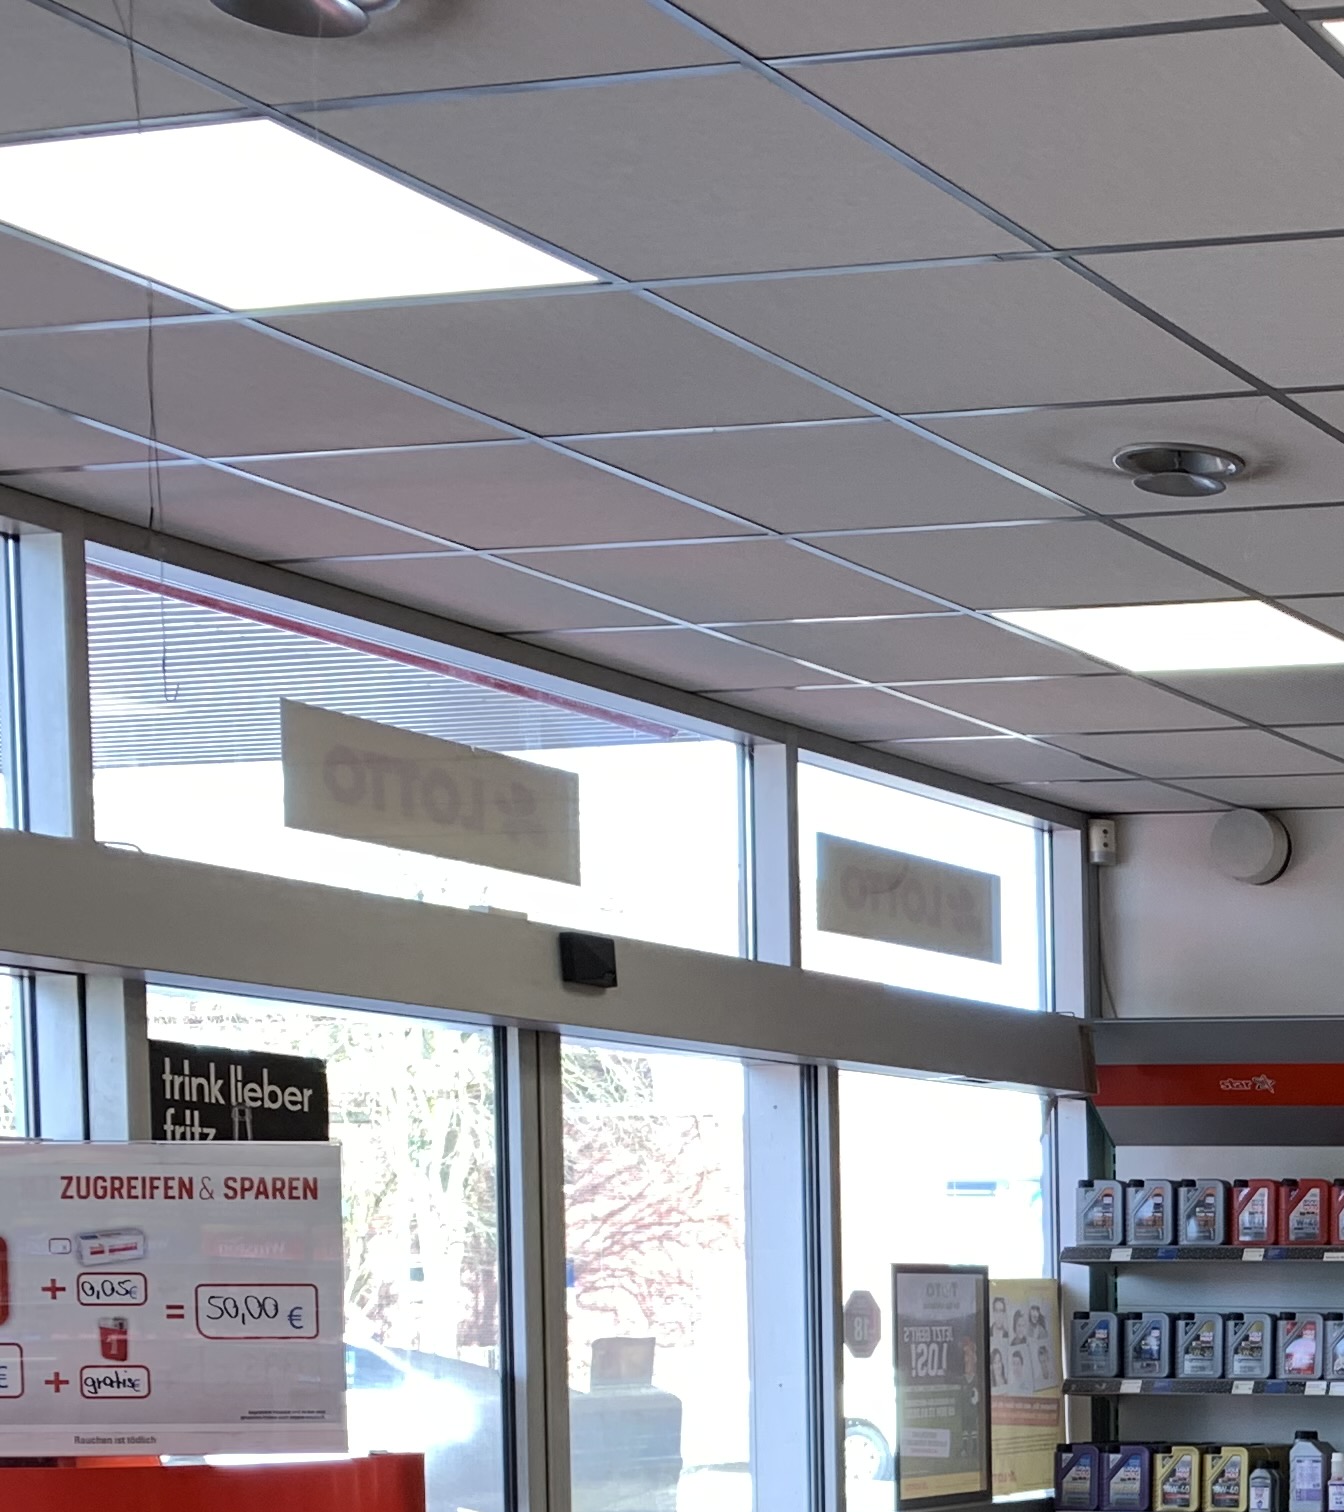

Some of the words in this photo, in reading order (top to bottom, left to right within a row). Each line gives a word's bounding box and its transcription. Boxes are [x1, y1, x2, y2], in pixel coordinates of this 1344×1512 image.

[163, 1058, 224, 1104] trink
[231, 1062, 313, 1113] lieber
[1219, 1077, 1251, 1091] star
[163, 1108, 217, 1141] fritz
[60, 1176, 194, 1200] ZUGREIFEN
[199, 1176, 215, 1200] &
[223, 1177, 318, 1200] SPAREN
[206, 1295, 279, 1325] 50,00
[287, 1306, 304, 1329] €
[74, 1435, 112, 1445] Rauchen
[127, 1435, 156, 1446] tödlich
